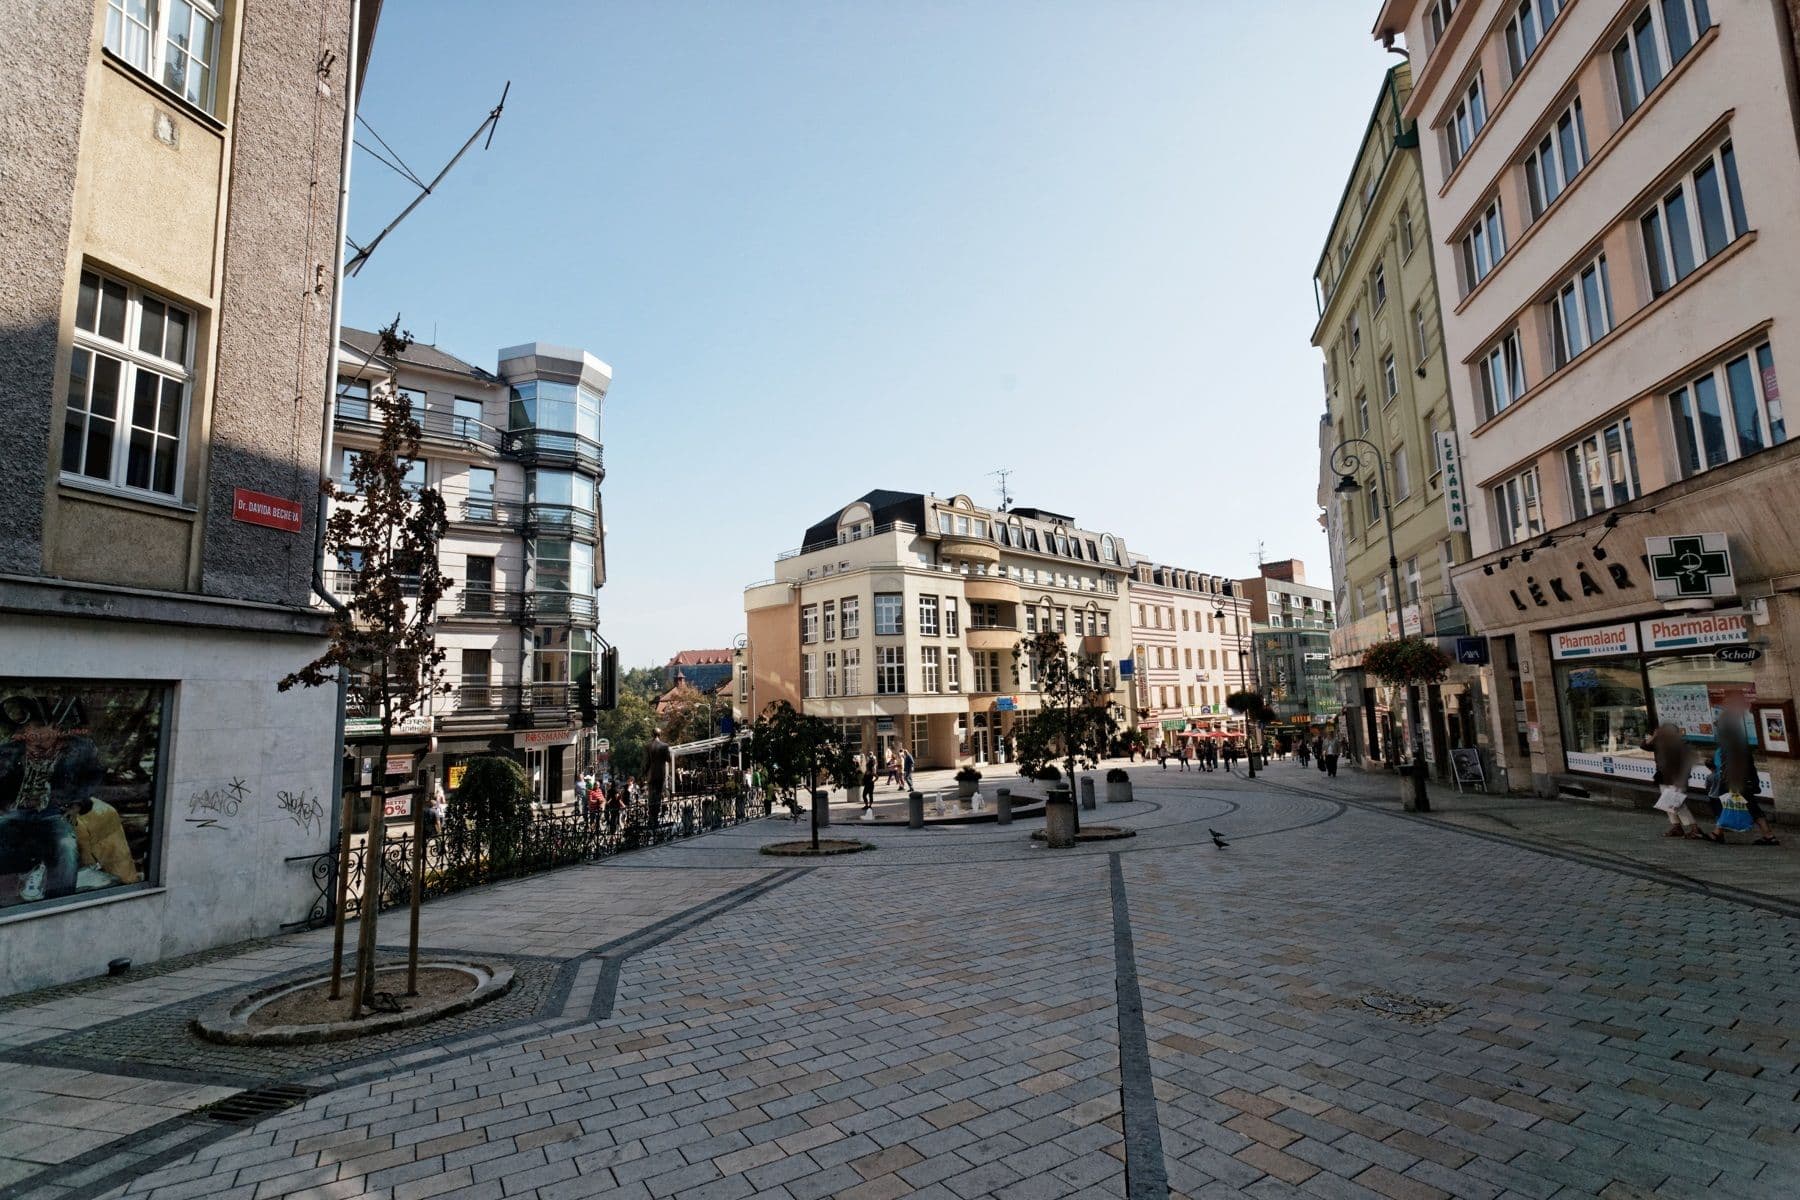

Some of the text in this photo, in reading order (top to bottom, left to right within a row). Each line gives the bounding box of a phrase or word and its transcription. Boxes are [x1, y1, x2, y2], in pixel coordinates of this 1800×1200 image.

[1444, 438, 1462, 525] LÉKÁRNA
[238, 499, 248, 511] Dr.
[249, 502, 271, 516] DAVIDA
[1559, 628, 1626, 649] Pharmaland
[1698, 633, 1741, 644] LÉKÁRNA
[1462, 650, 1480, 659] AXA
[1591, 645, 1619, 654] LÉKÁRNA
[1721, 649, 1755, 661] Scholl
[525, 731, 570, 742] ROSSMANN
